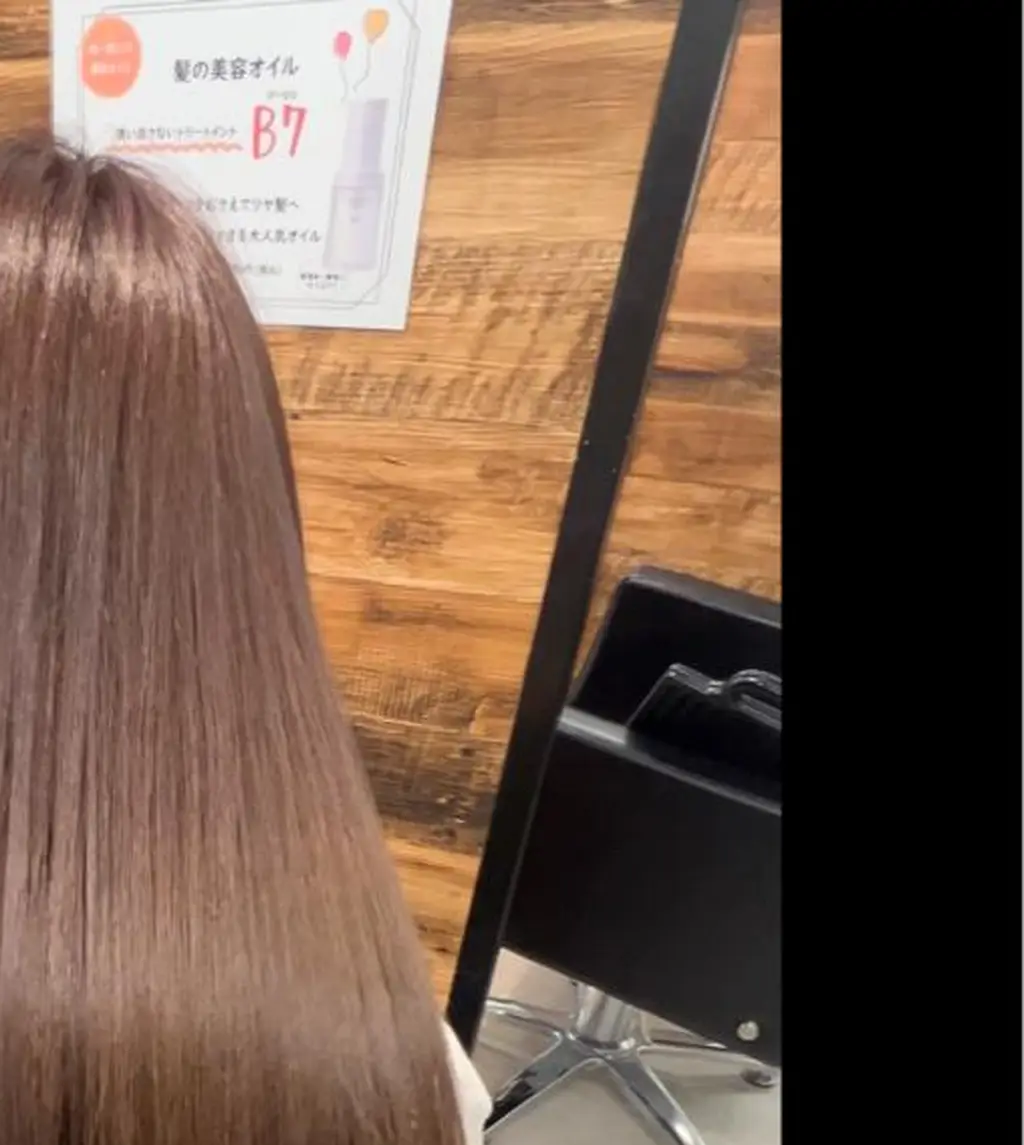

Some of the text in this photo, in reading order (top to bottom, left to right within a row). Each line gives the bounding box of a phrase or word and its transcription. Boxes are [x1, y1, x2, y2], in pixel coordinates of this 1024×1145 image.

[173, 55, 299, 83] 髪の美容オイル
[253, 104, 307, 160] B7
